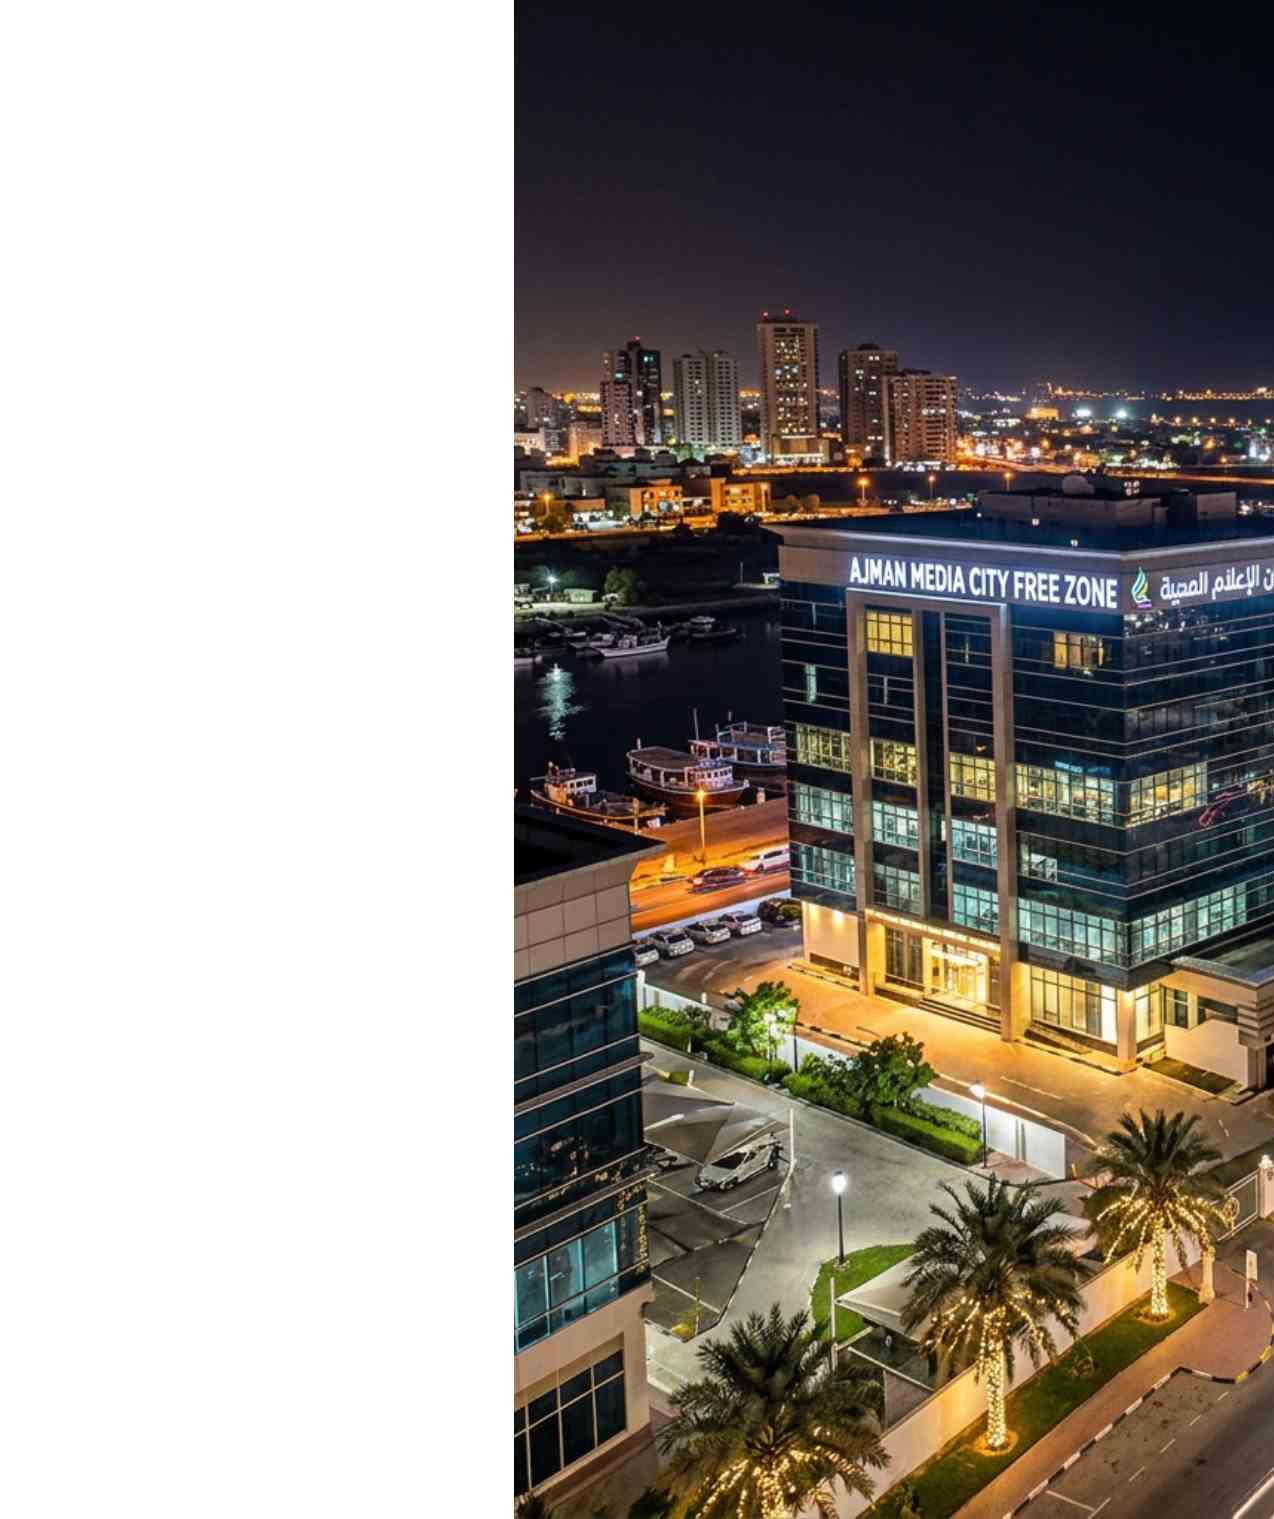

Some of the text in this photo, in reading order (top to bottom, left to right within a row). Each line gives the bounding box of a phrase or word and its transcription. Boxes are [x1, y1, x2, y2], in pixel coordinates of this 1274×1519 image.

[850, 556, 1118, 609] AJMAN MEDIA CITY FREE ZONE
